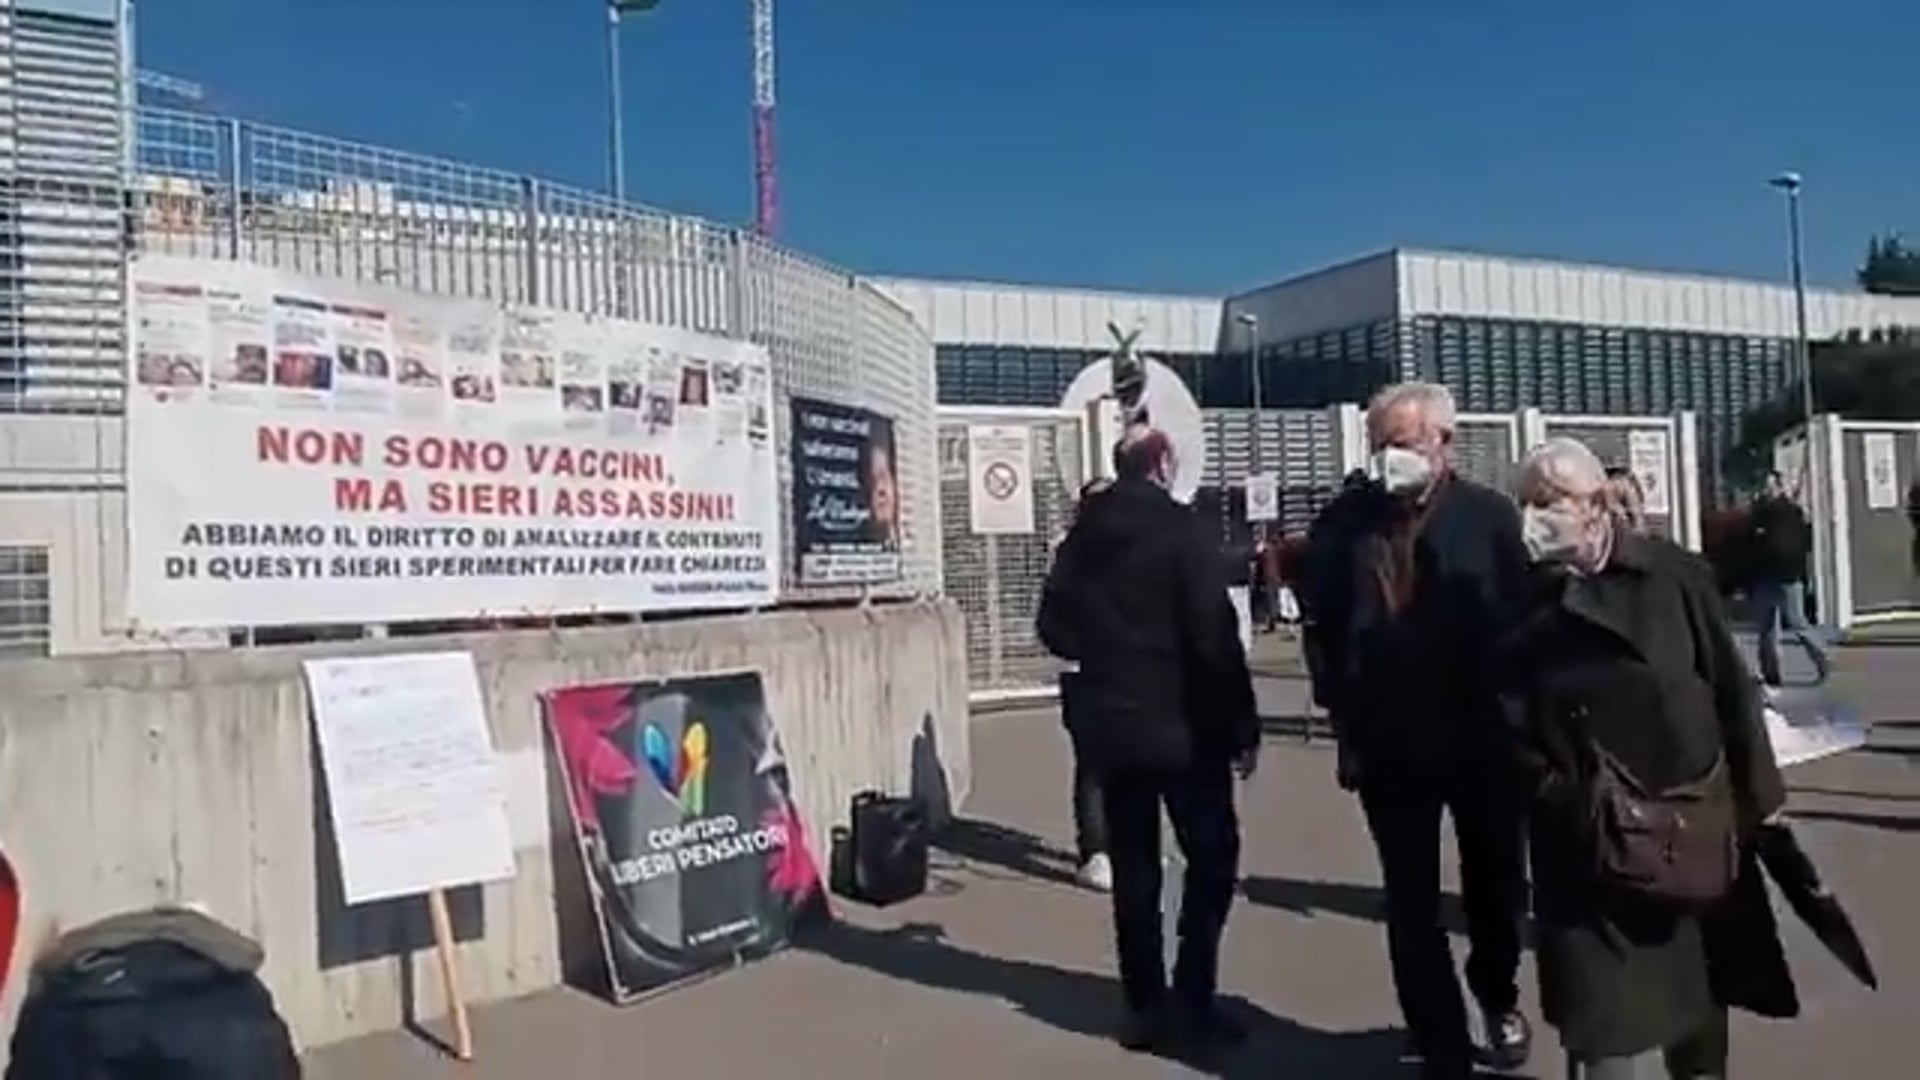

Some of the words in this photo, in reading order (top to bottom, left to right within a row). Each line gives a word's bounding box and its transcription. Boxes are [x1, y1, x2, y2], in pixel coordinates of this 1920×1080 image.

[257, 425, 363, 465] NON
[384, 435, 508, 472] SONO
[526, 445, 675, 486] VACCINI,
[334, 478, 407, 513] MA
[428, 482, 538, 516] SIERI
[554, 488, 734, 521] ASSASSINI!
[182, 524, 326, 547] ABBIAMO
[334, 526, 358, 546] IL
[367, 526, 475, 548] DIRITTO
[483, 528, 506, 547] DI
[513, 529, 643, 548] ANALIZZARE
[165, 557, 197, 580] DI
[207, 556, 322, 582] QUESTI
[330, 557, 401, 578] SIERI
[408, 557, 585, 577] SPERIMENTALI
[590, 556, 625, 575] PER
[630, 556, 676, 574] FARE
